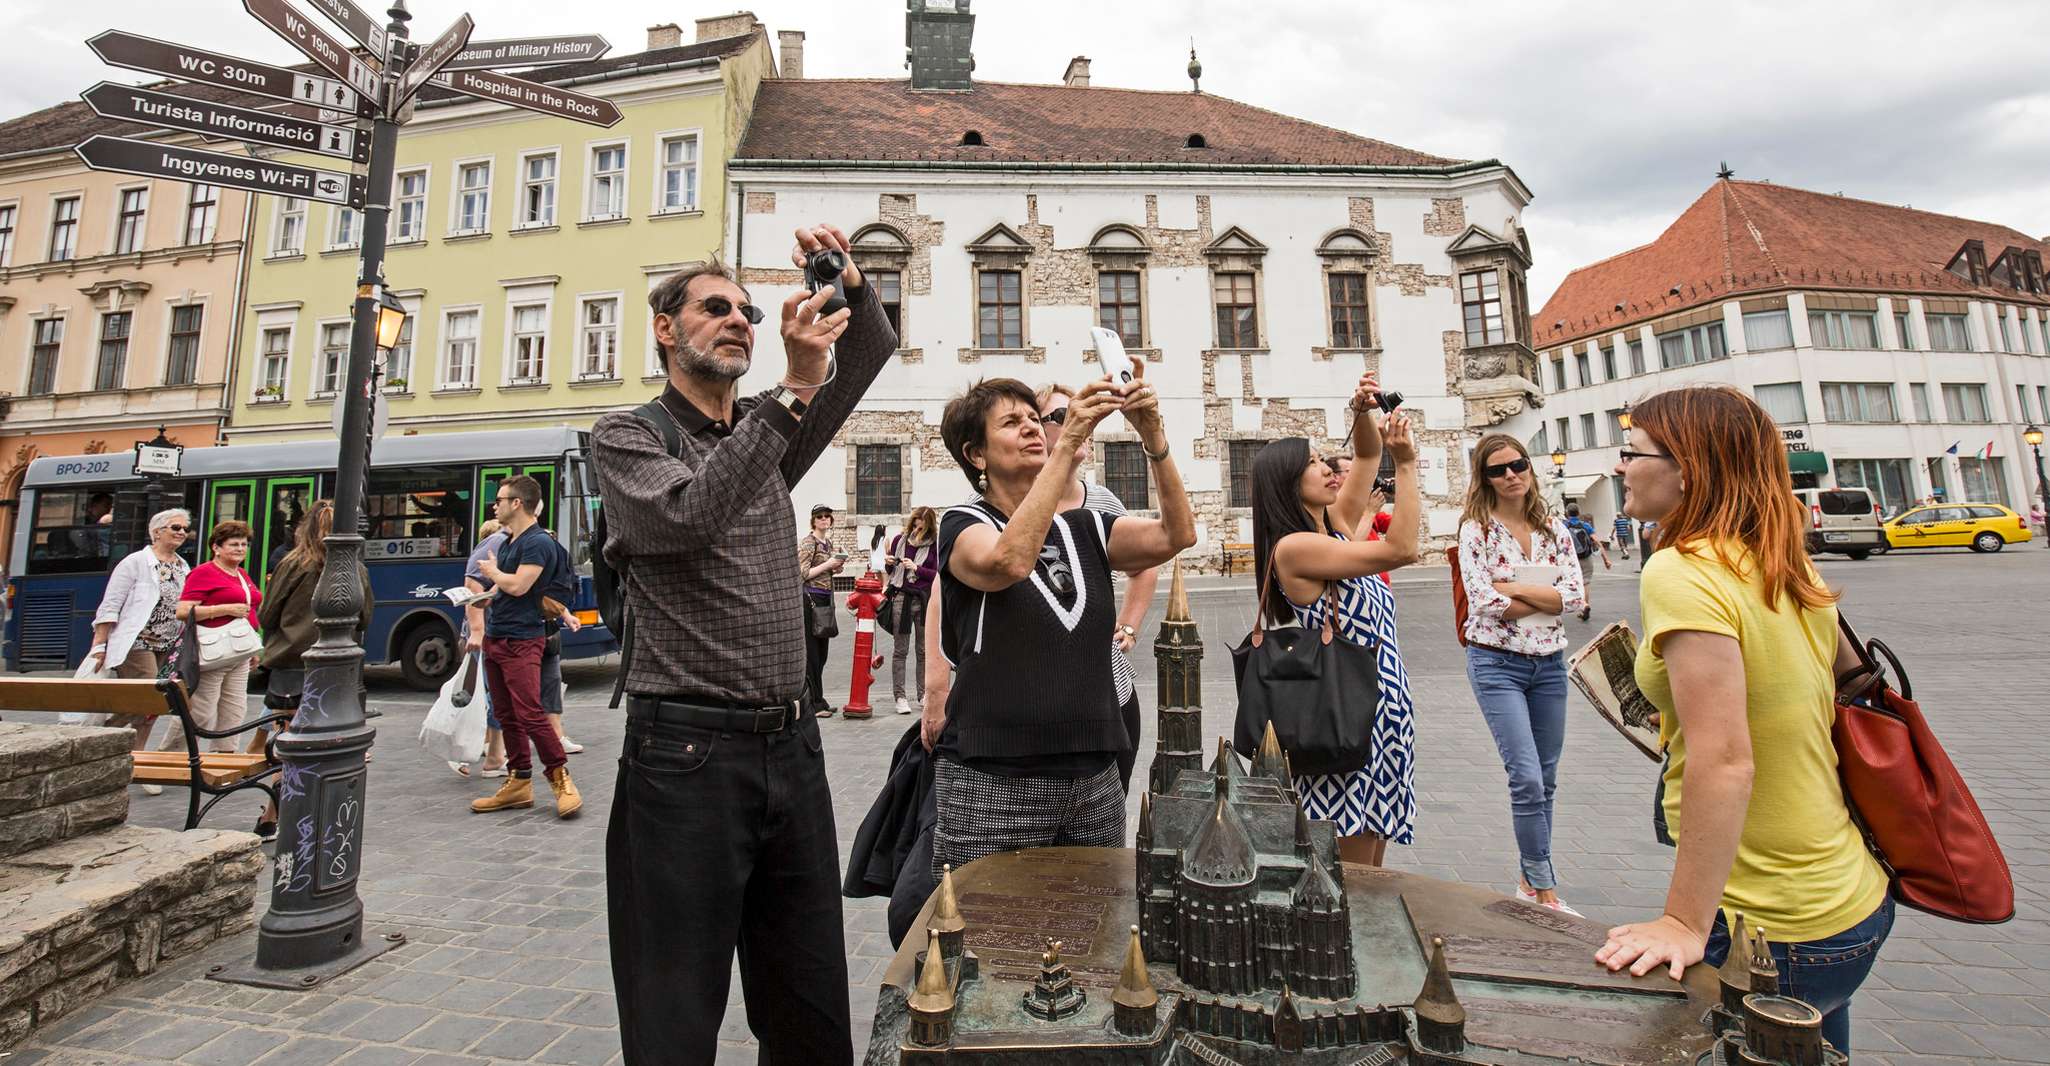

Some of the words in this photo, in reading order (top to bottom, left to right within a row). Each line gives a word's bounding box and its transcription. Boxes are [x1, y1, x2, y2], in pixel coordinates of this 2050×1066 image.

[325, 0, 350, 20] stya
[285, 12, 307, 39] WC
[311, 34, 339, 65] 190m
[453, 48, 492, 61] useum
[495, 46, 506, 58] of
[509, 44, 550, 57] Military
[553, 42, 592, 54] History
[178, 54, 216, 75] WC
[222, 65, 266, 86] 30m
[464, 73, 522, 98] Hospital
[525, 89, 538, 102] in
[541, 92, 563, 108] the
[566, 99, 600, 117] Rock
[131, 96, 203, 123] Turista
[209, 110, 315, 143] Információ
[161, 153, 256, 181] Ingyenes
[260, 168, 310, 189] Wi-Fi
[56, 461, 110, 476] BPO-202
[399, 541, 414, 554] 16
